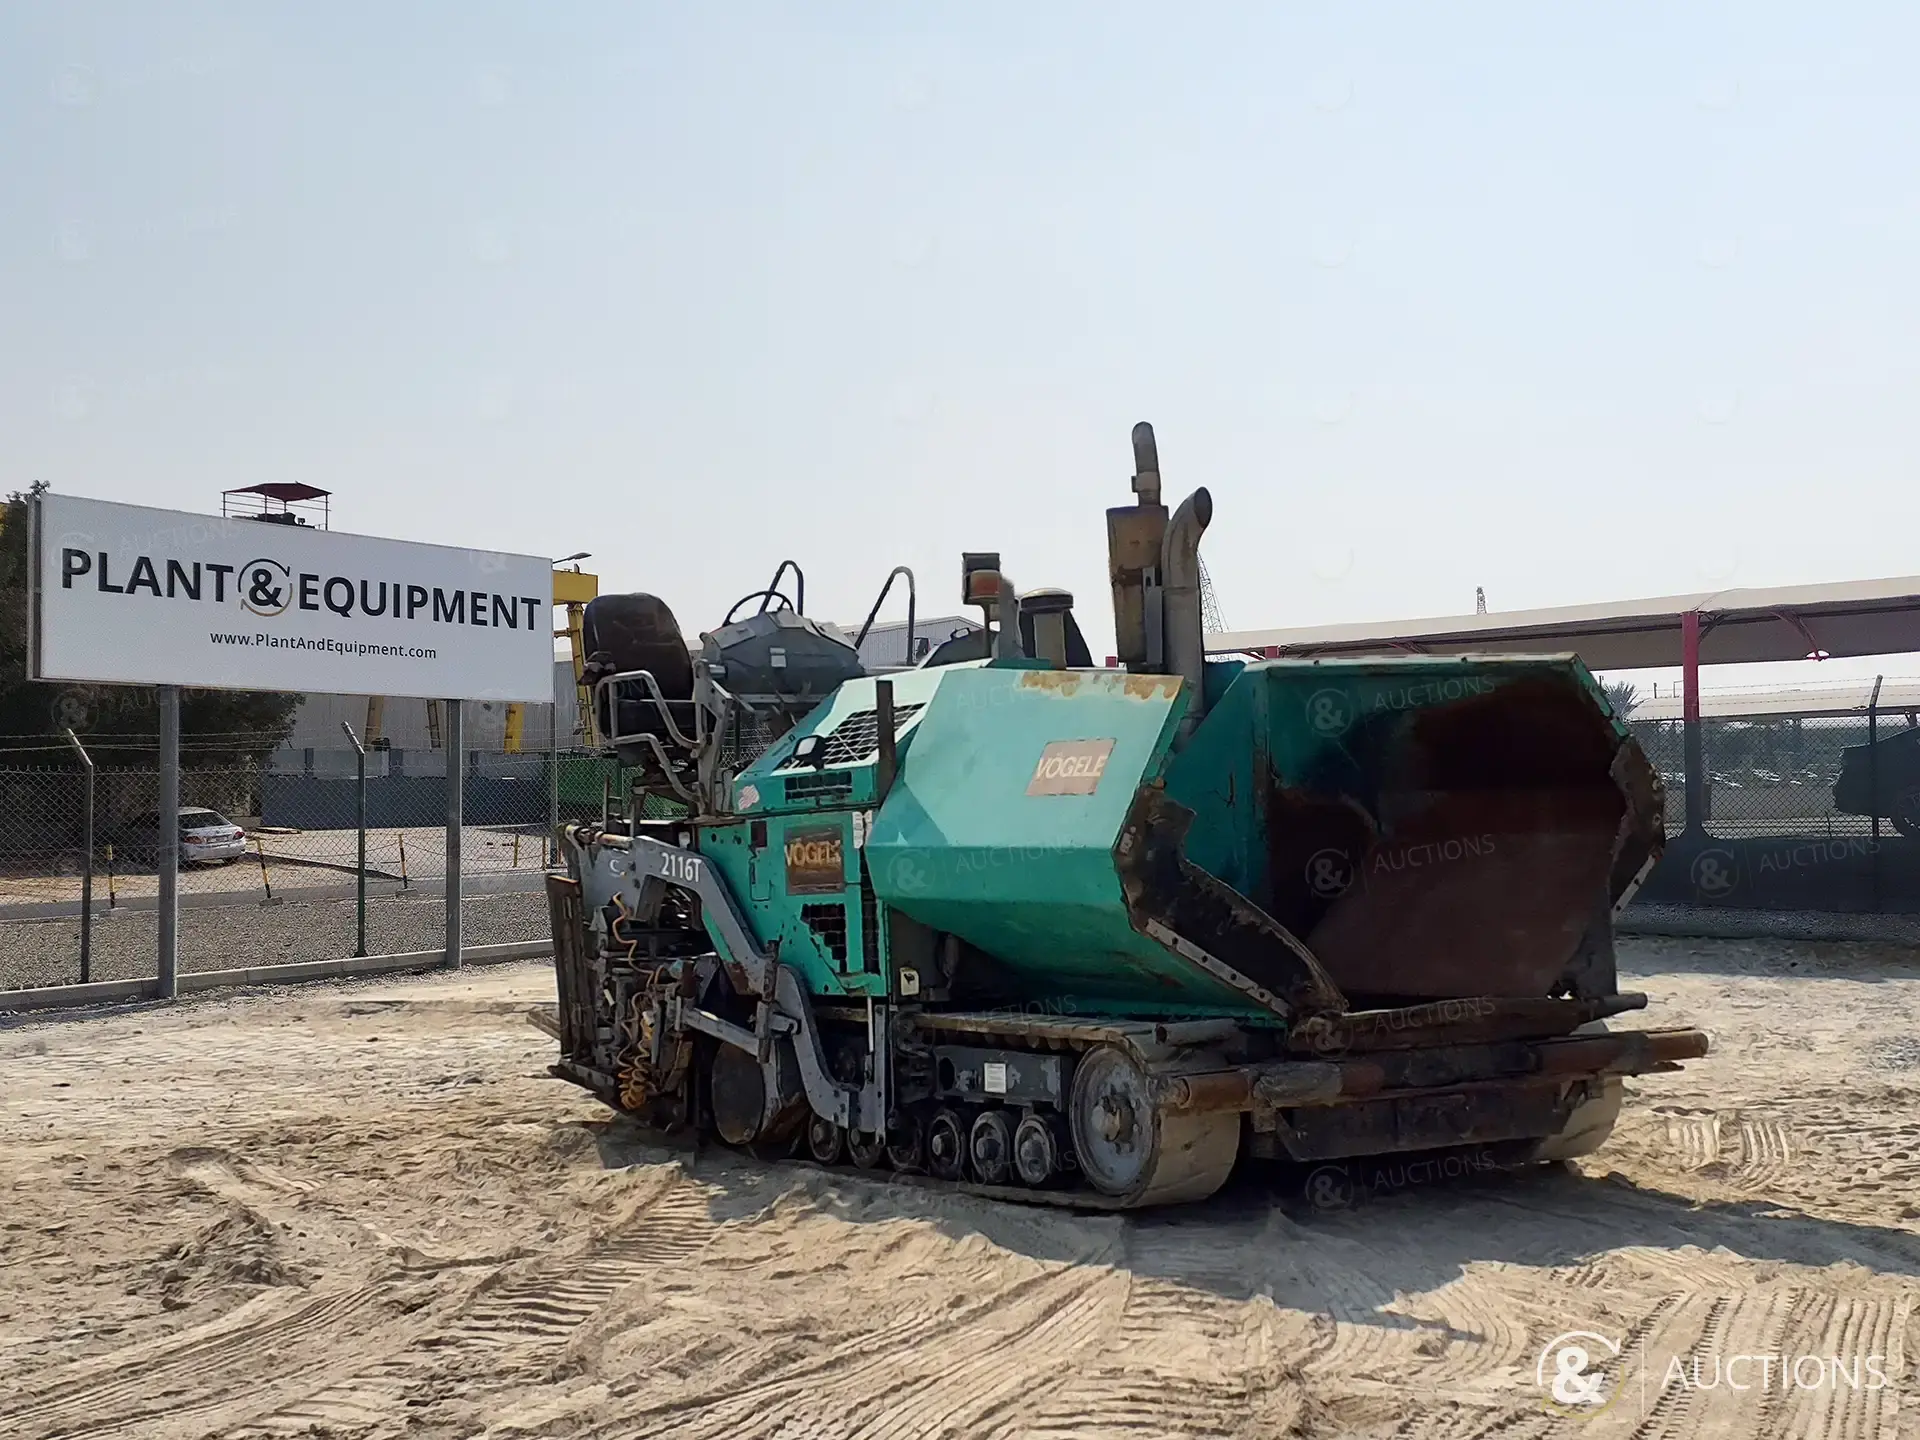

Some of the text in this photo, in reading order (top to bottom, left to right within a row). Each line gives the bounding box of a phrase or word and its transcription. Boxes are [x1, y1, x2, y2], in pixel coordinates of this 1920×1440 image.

[62, 548, 234, 602] PLANT
[299, 573, 541, 631] EQUIPMENT
[210, 632, 437, 659] www.PlantAndEquipment.com
[661, 852, 702, 882] 2116T
